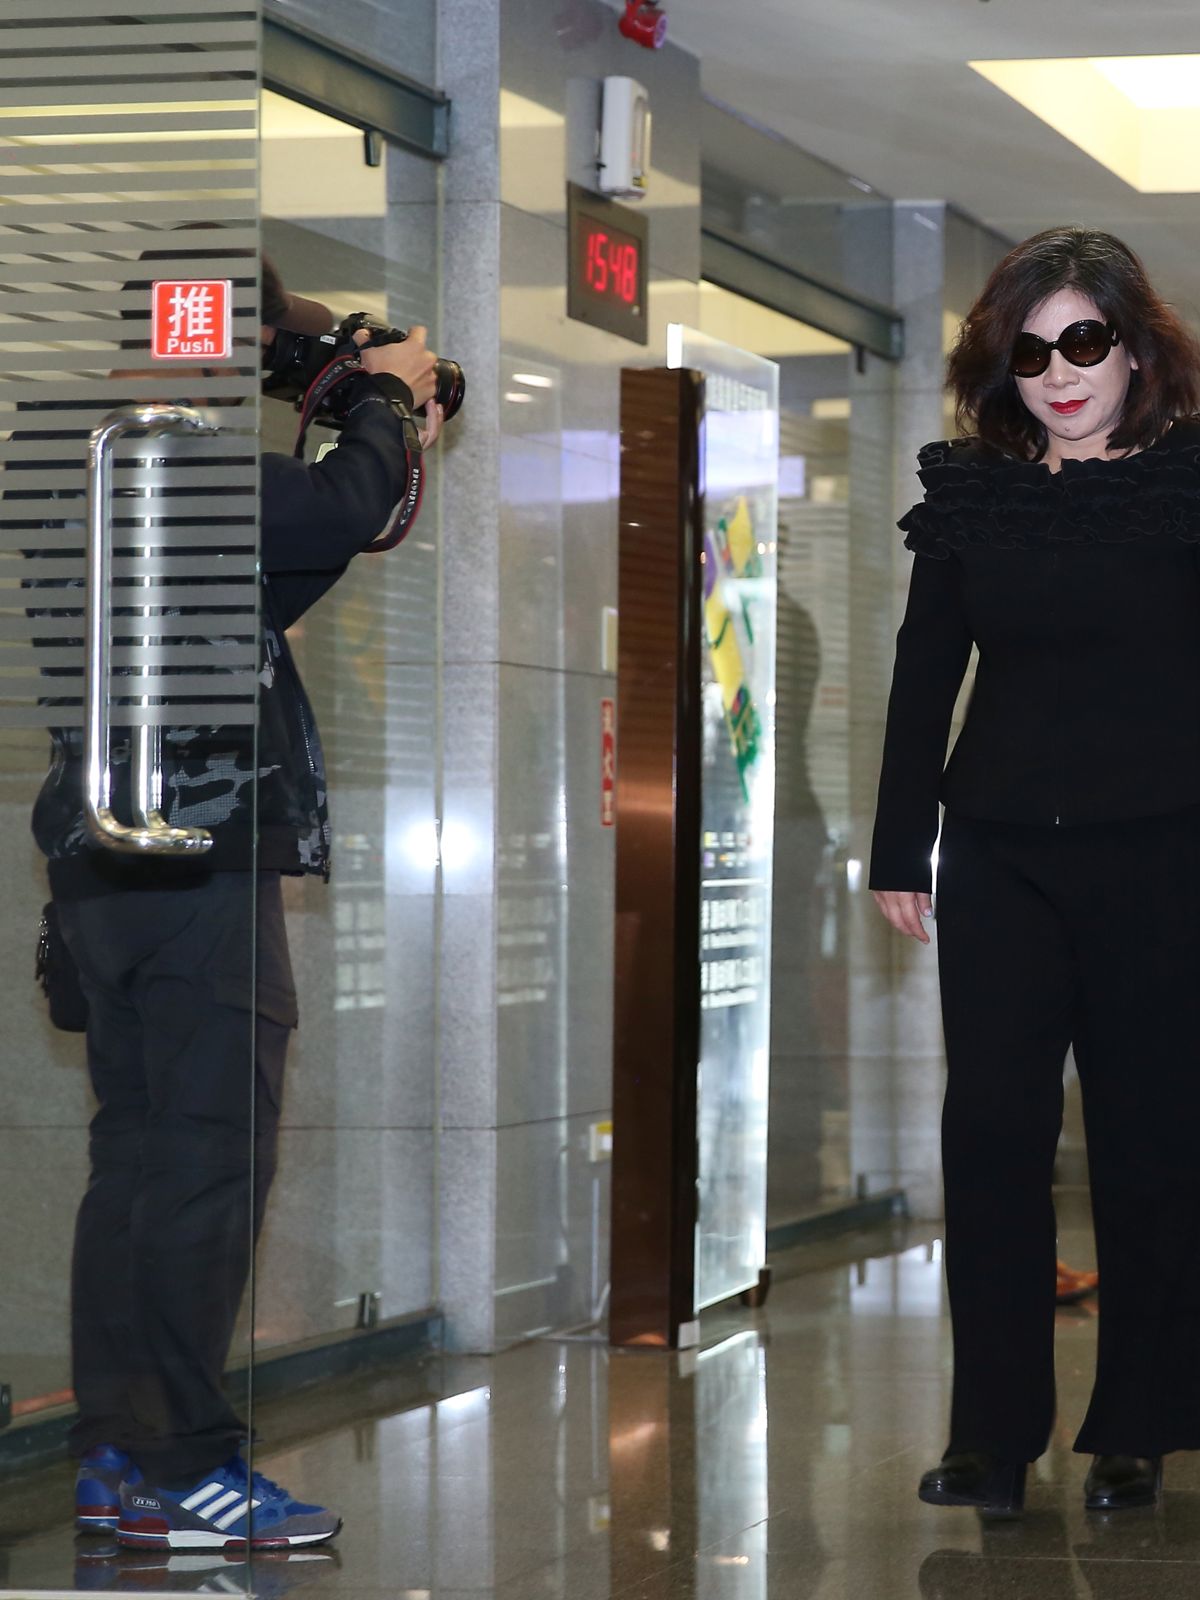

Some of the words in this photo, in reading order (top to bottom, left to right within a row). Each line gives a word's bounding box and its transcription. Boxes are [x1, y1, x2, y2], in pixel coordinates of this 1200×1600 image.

[587, 233, 637, 303] 1548
[168, 286, 213, 337] 推
[167, 338, 214, 353] Push
